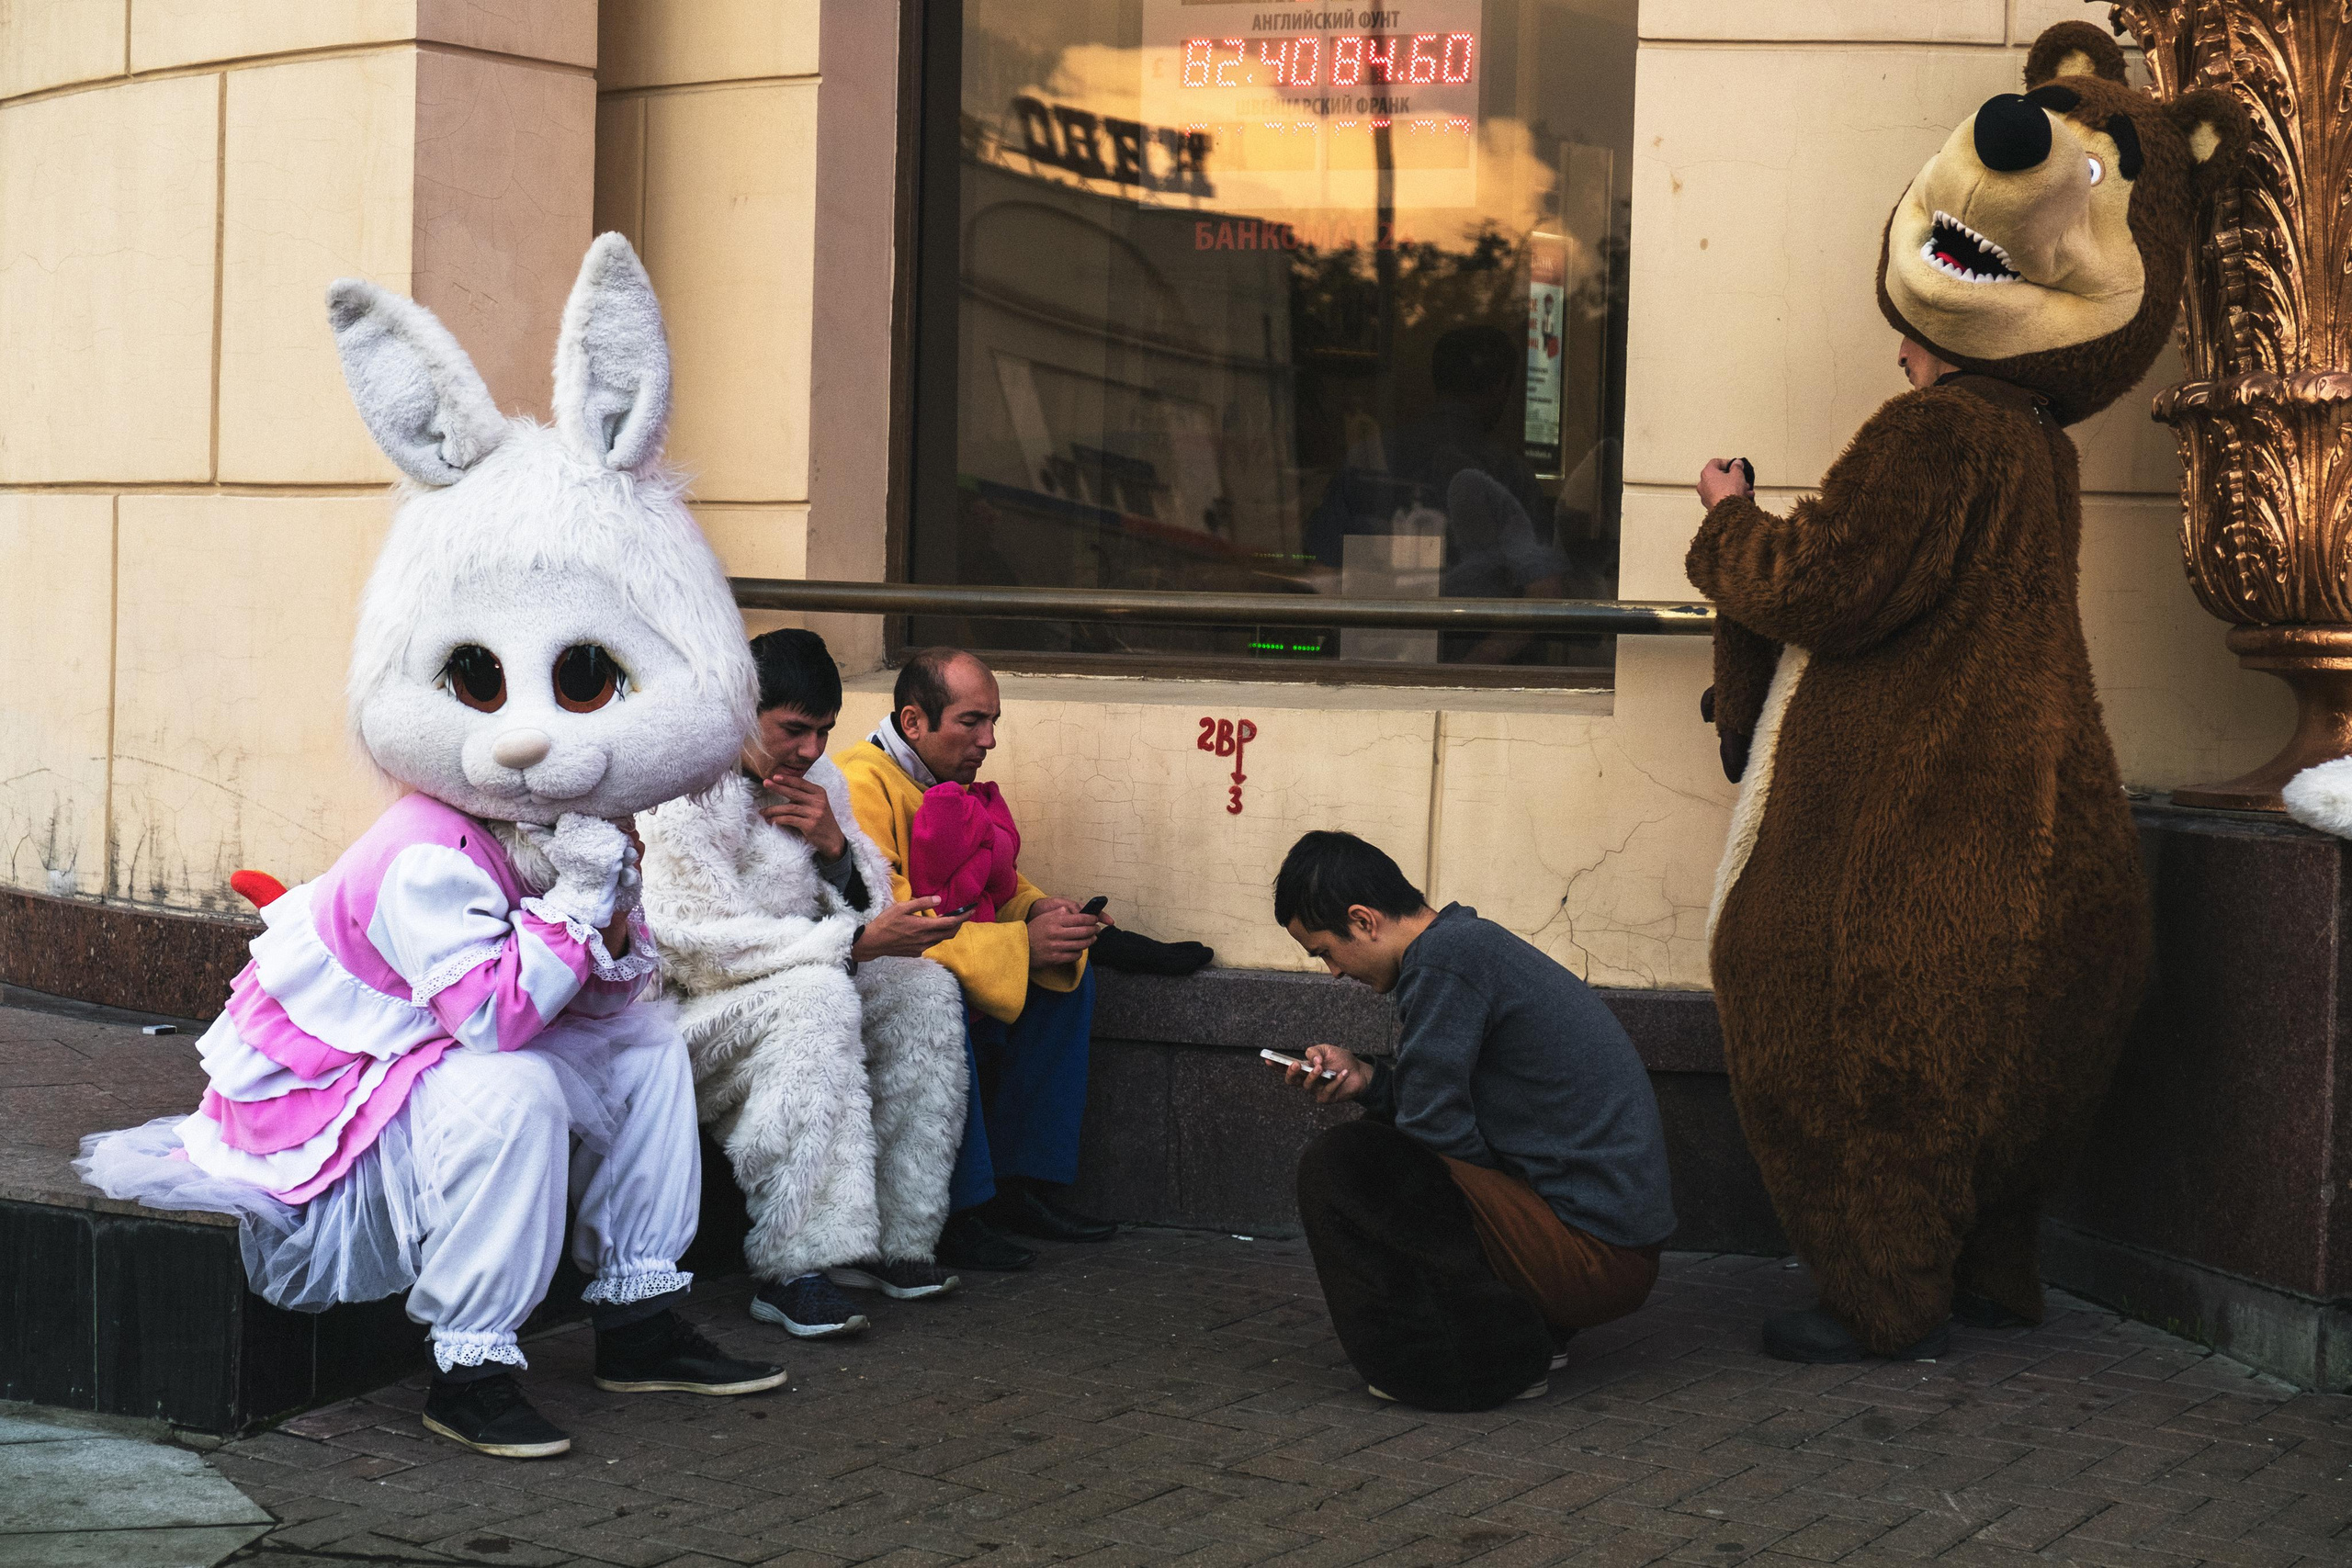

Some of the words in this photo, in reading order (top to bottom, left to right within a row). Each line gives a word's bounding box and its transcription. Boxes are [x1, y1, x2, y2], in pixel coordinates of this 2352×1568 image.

[1251, 8, 1354, 31] АНГЛИЙСКИЙ
[1358, 9, 1401, 29] ФУНТ
[1183, 37, 1319, 87] 82.40
[1332, 33, 1474, 85] 84.60
[1356, 96, 1410, 114] ФРАНК
[1226, 784, 1243, 816] 3
